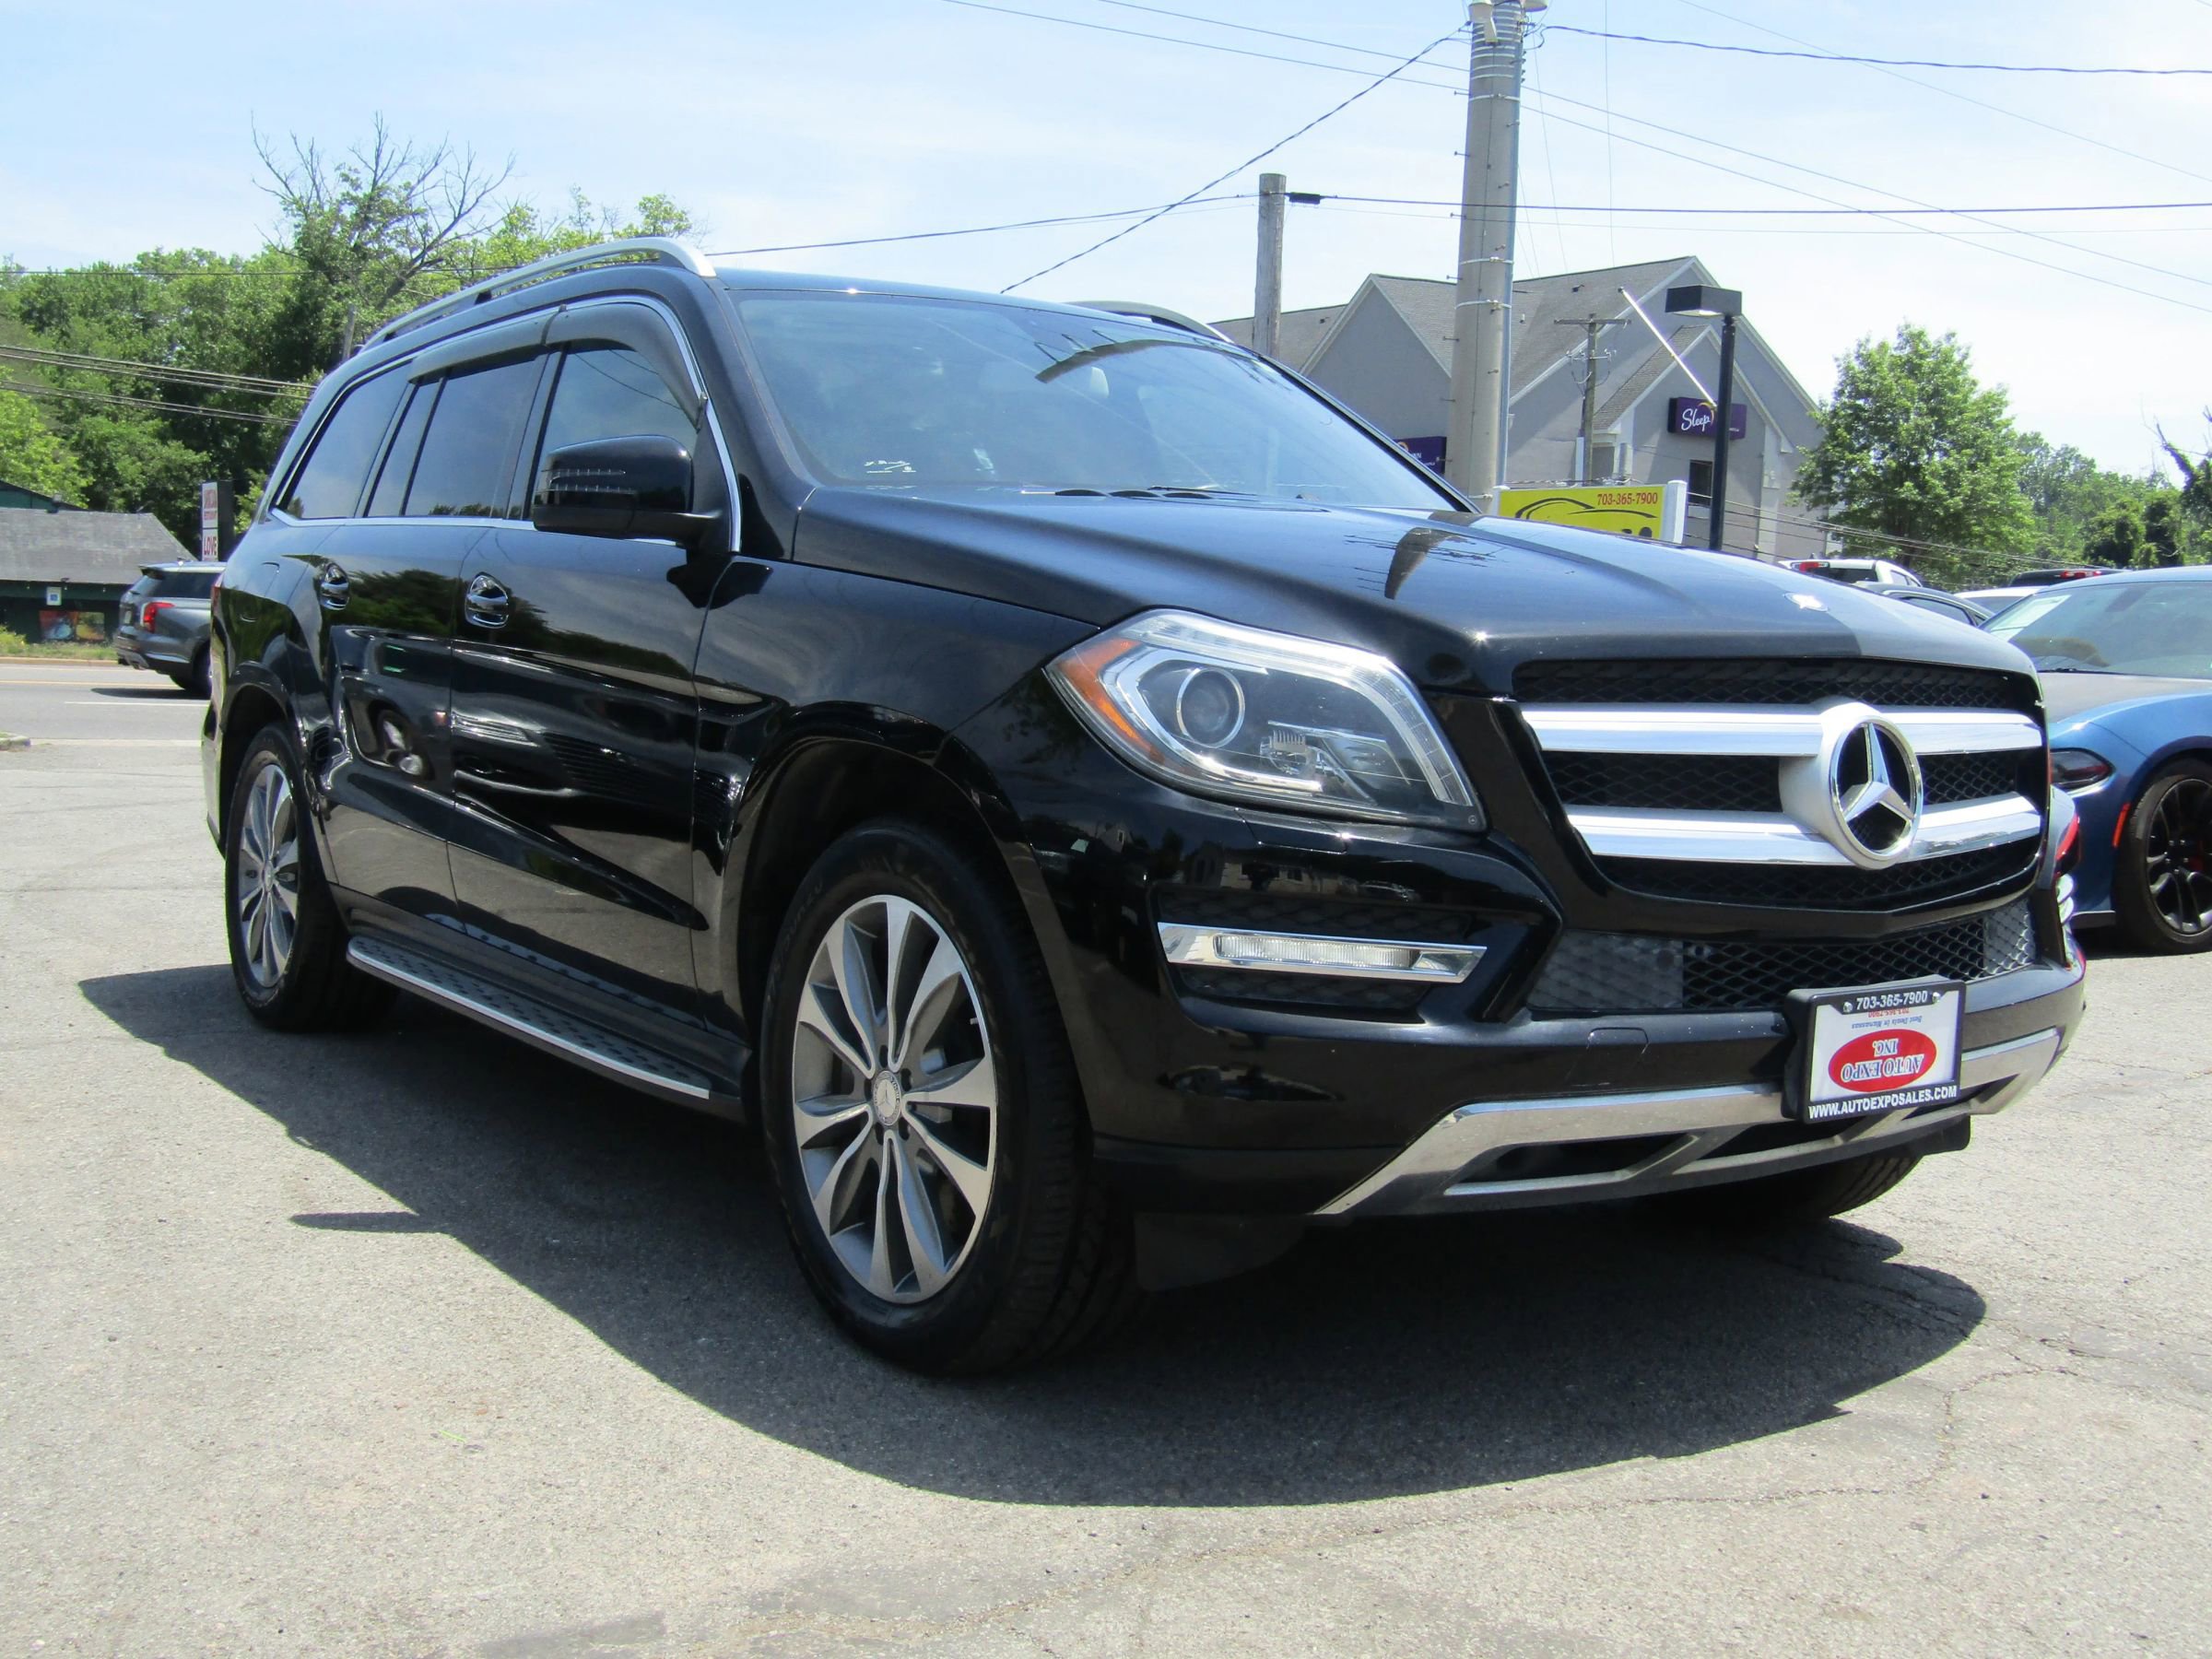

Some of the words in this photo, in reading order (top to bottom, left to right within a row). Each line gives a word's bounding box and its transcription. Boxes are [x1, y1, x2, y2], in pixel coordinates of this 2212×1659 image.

[1681, 408, 1711, 432] Sleep
[1597, 492, 1658, 505] 703-365-7900
[204, 536, 217, 556] LOVE
[1856, 991, 1927, 1010] 703-365-7900
[1872, 1039, 1899, 1056] INC.
[1841, 1060, 1882, 1083] EXPO
[1883, 1054, 1924, 1077] AUTO
[1808, 1086, 1957, 1119] WWW.AUTOEXPOSALES.COM
